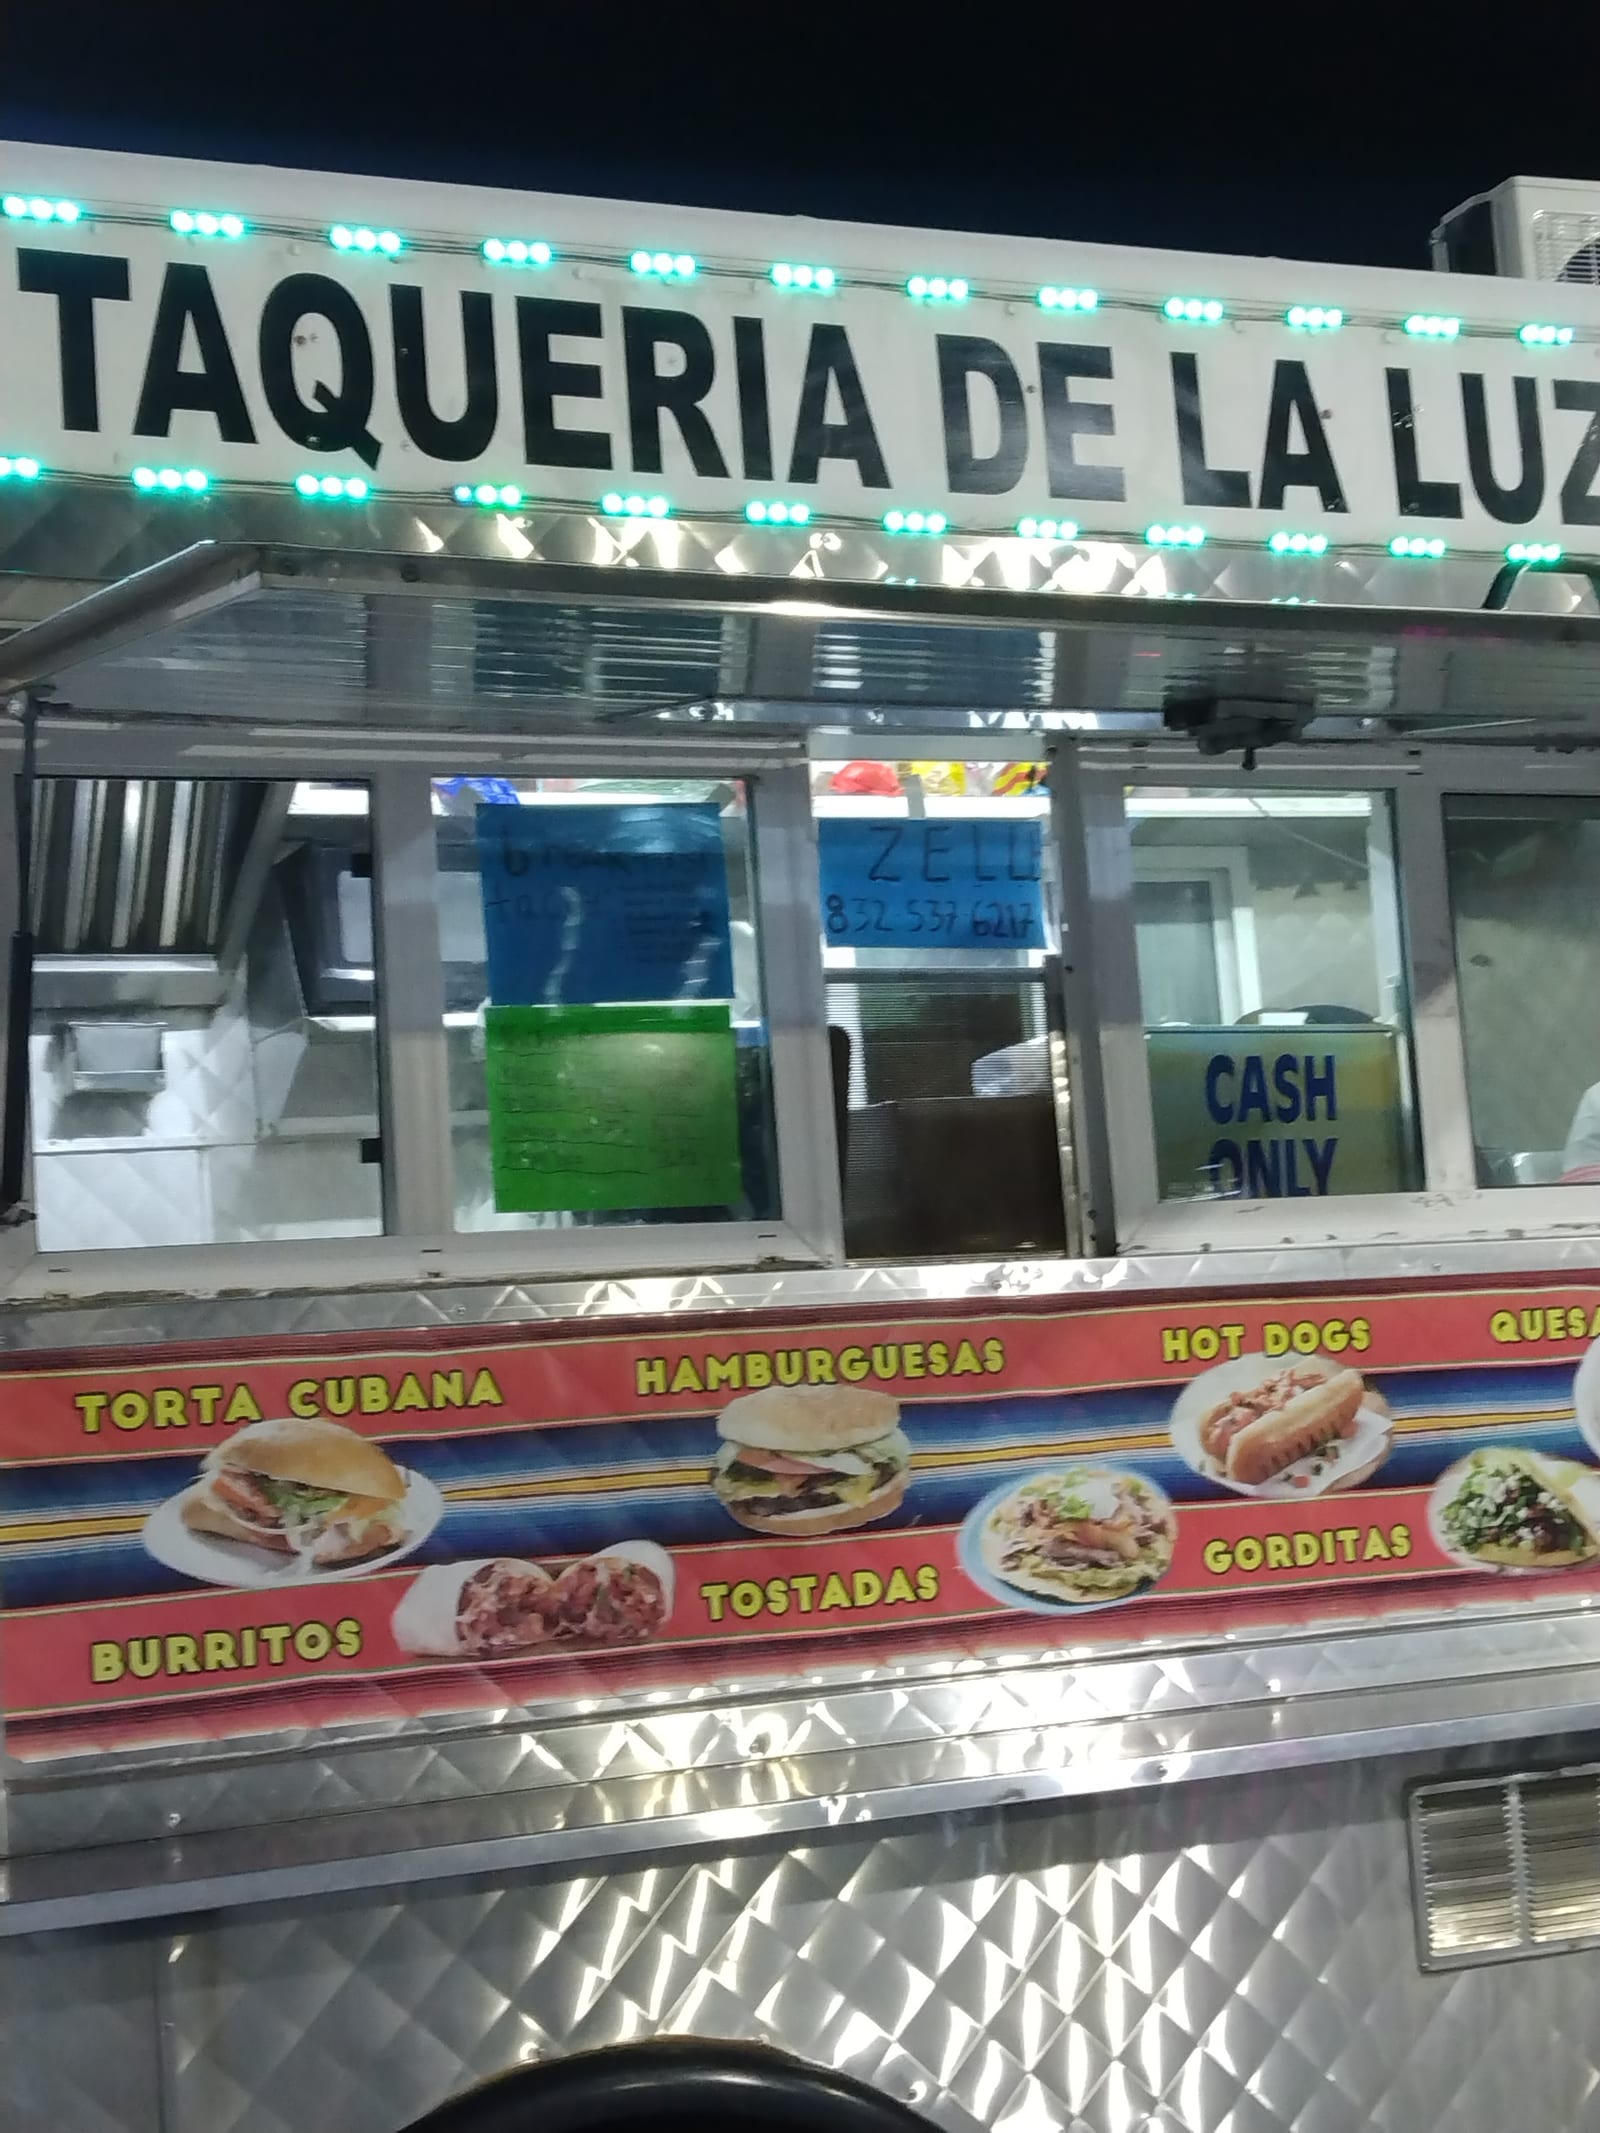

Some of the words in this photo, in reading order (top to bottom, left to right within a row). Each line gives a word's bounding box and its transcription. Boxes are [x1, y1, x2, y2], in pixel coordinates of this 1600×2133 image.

[17, 248, 893, 491] TAQUERIA
[936, 333, 1127, 502] DE
[1170, 351, 1350, 514] LA
[1384, 366, 1600, 526] LUZ
[826, 894, 895, 934] 832
[1205, 1053, 1338, 1125] CASH
[1209, 1138, 1339, 1199] ONLY
[636, 1337, 1006, 1397] HAMBURGUESAS
[1161, 1323, 1246, 1363] HOT
[1264, 1318, 1372, 1358] DOGS
[75, 1382, 262, 1433] TORTA
[288, 1368, 503, 1419] CUBANA
[1203, 1524, 1412, 1575] GORDITAS
[702, 1565, 939, 1621] TOSTADAS
[91, 1618, 363, 1684] BURRITOS
